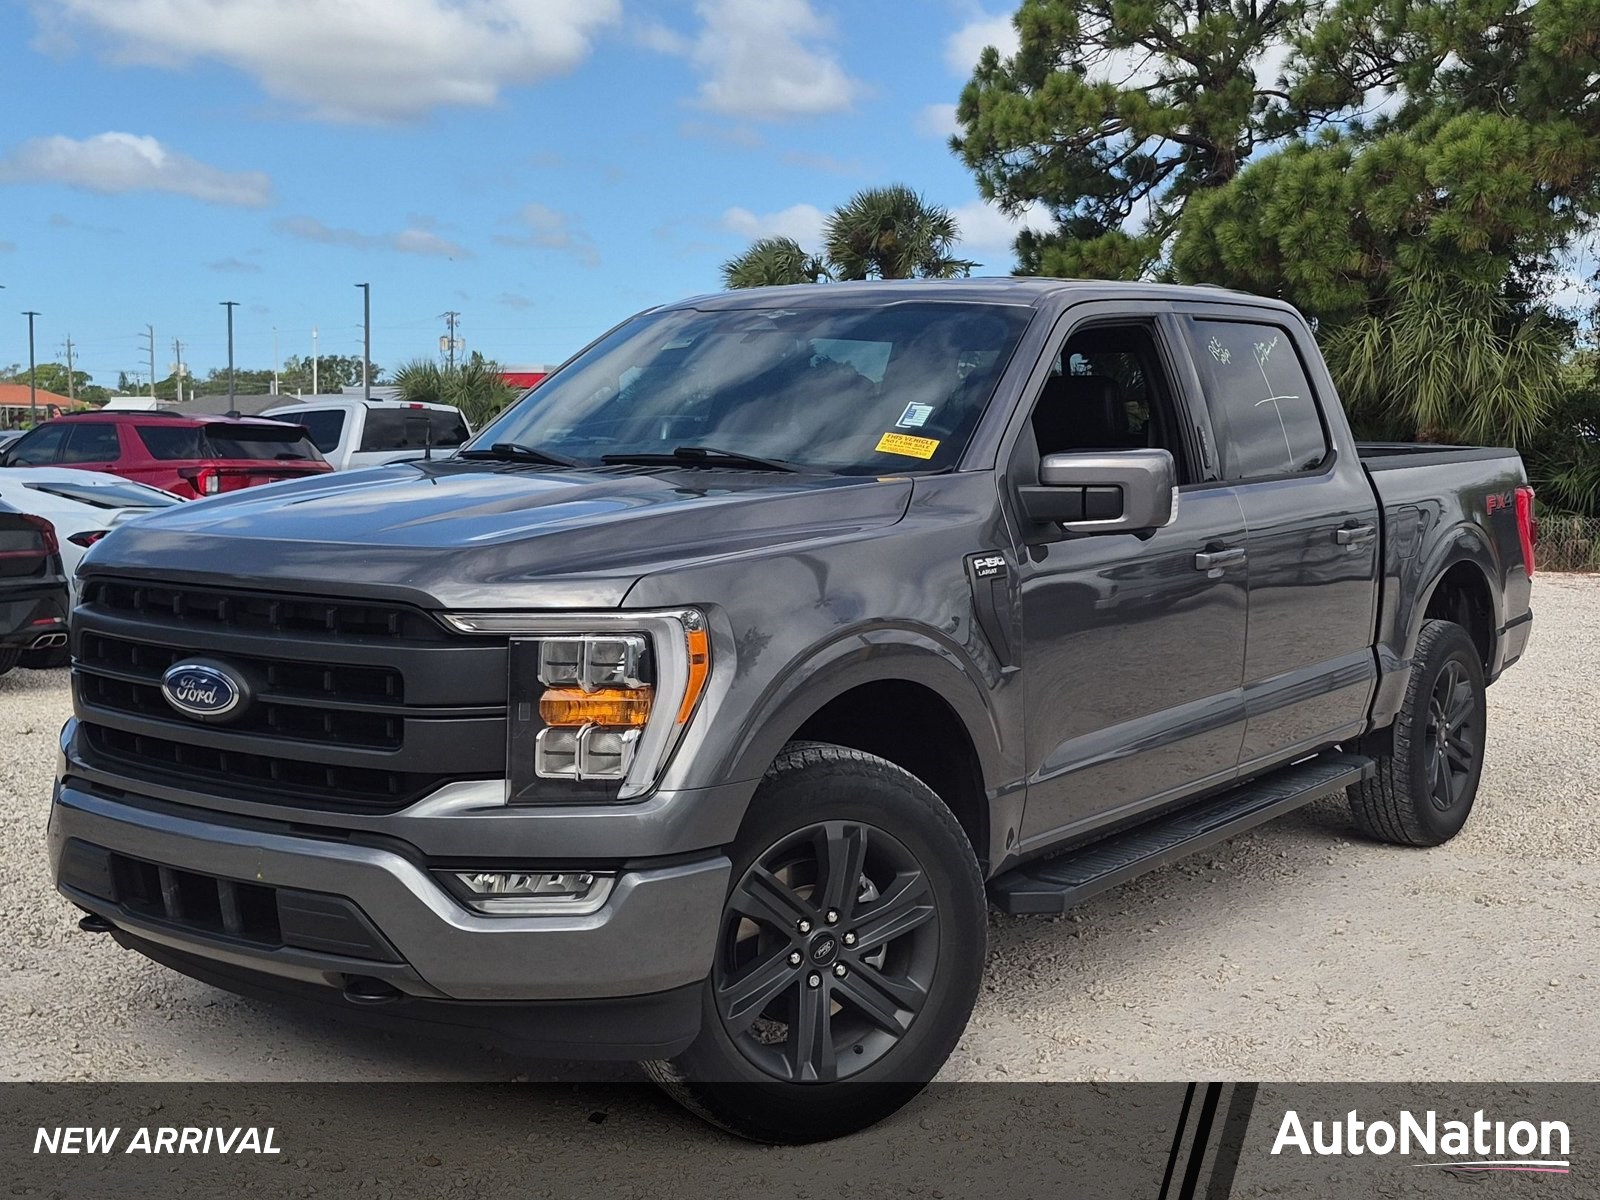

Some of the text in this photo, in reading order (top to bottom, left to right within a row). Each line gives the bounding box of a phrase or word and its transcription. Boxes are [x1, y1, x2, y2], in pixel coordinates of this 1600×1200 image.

[904, 436, 935, 446] VEHICLE
[1486, 491, 1512, 516] FX4
[974, 556, 1006, 570] F-150
[177, 675, 218, 705] Ford
